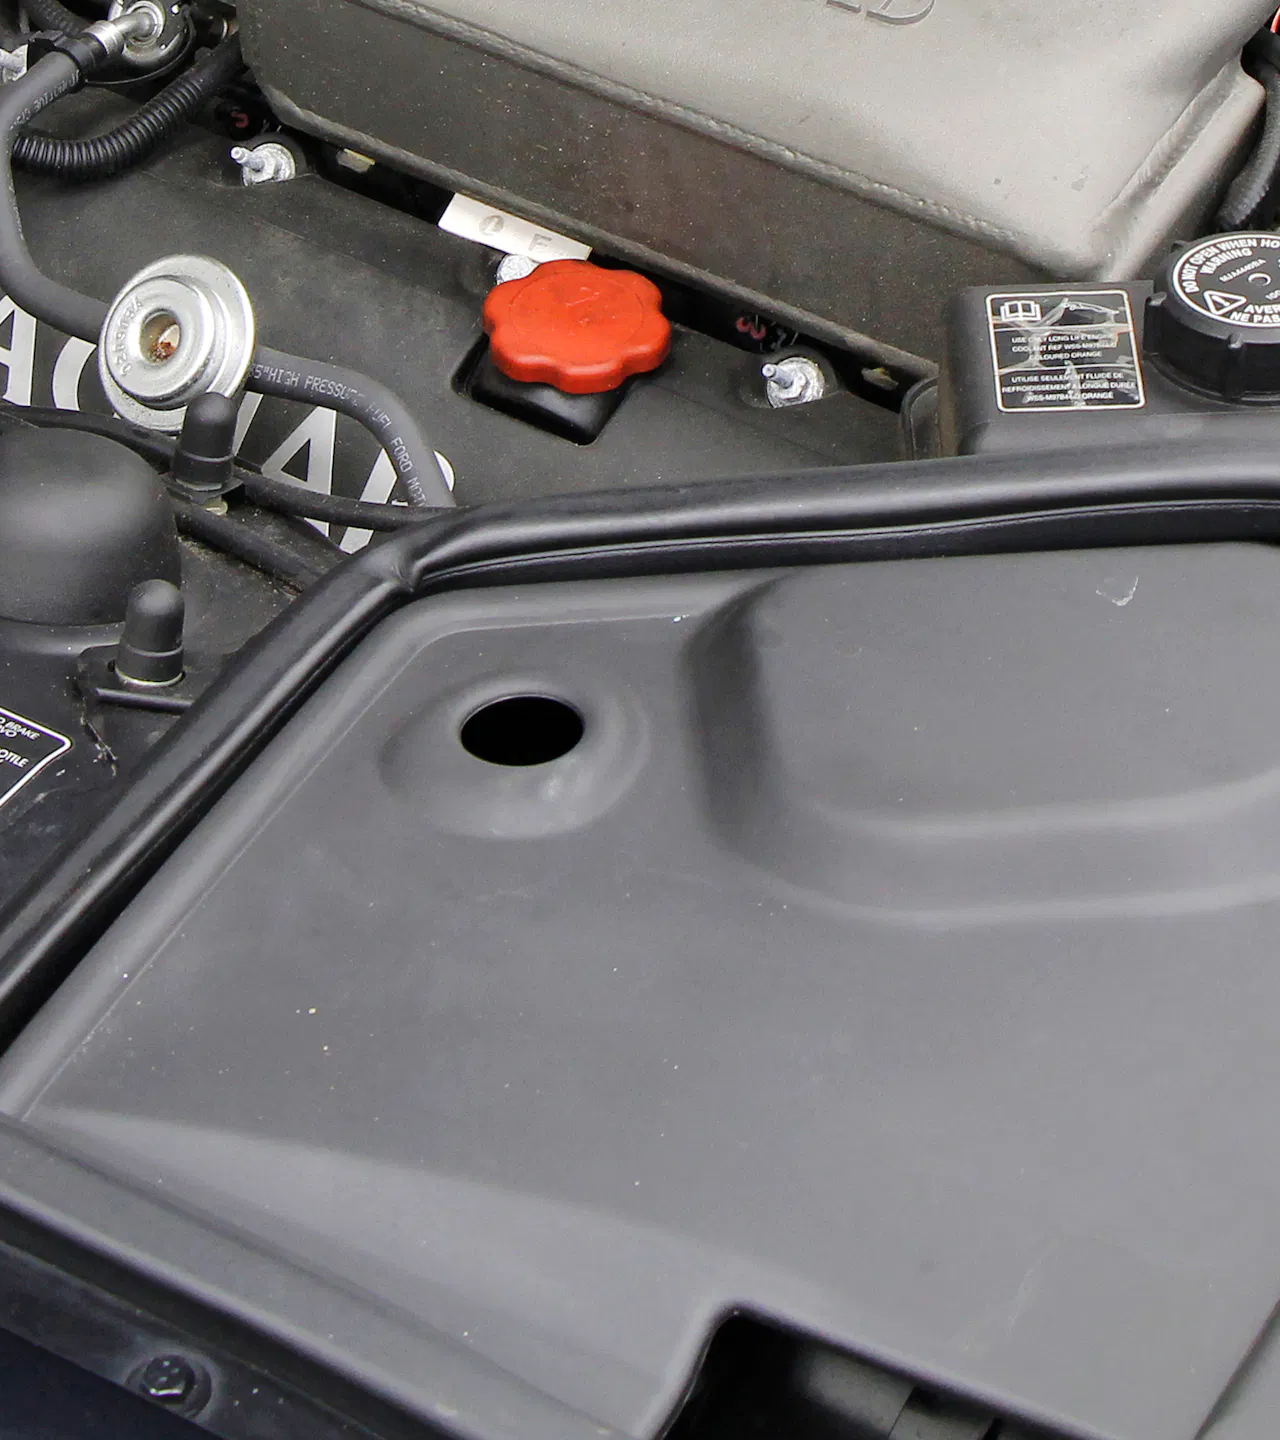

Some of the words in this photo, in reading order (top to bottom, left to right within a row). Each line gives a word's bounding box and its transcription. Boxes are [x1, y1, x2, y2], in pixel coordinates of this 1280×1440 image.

[1217, 238, 1258, 252] WHEN
[1189, 245, 1219, 265] OPEN
[1200, 248, 1253, 274] WARNING
[1181, 264, 1199, 281] NOT
[1182, 281, 1200, 294] DO
[1230, 311, 1249, 322] NE
[390, 436, 414, 474] FORD
[407, 475, 427, 507] MOT
[4, 719, 41, 741] BRAKE
